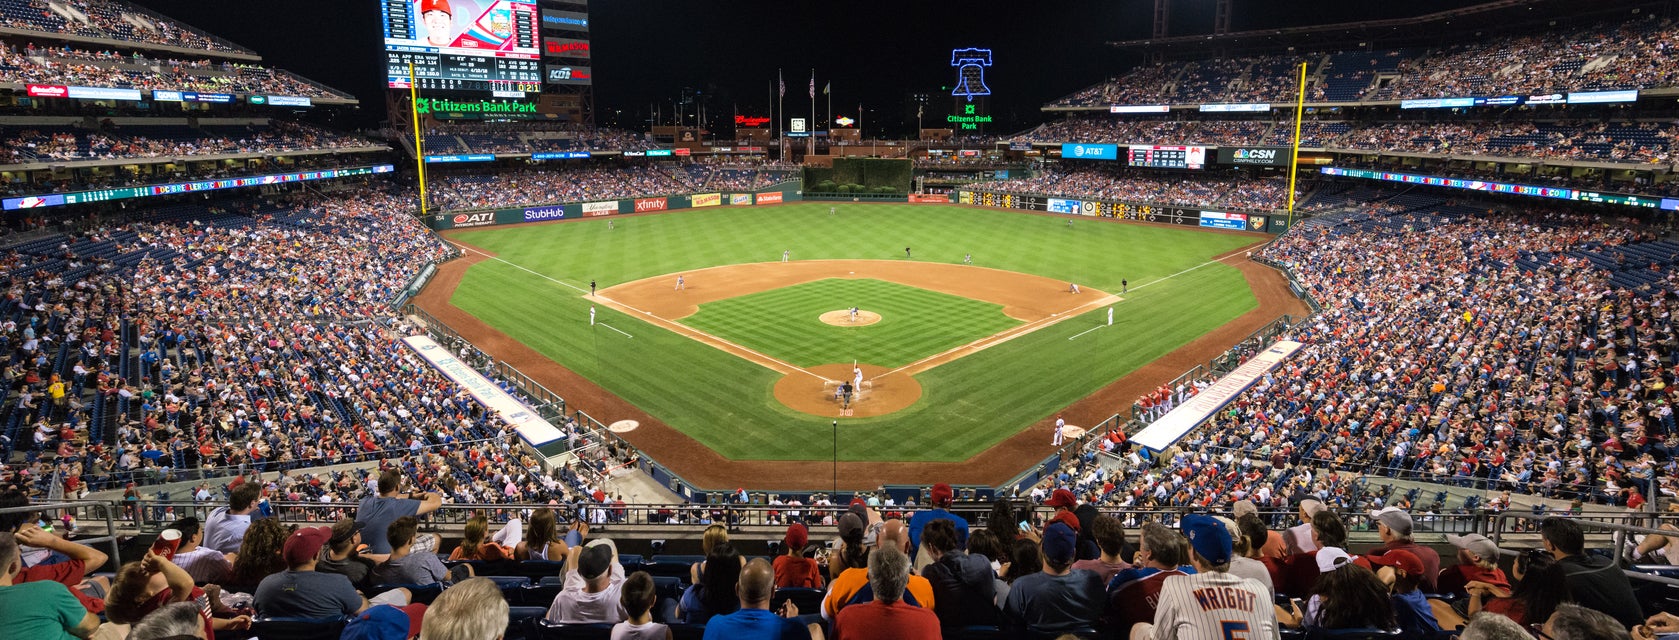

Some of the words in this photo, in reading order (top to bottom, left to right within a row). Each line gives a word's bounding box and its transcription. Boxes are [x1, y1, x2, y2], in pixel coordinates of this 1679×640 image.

[432, 100, 480, 112] Citizens
[483, 101, 510, 112] Bank
[513, 102, 536, 112] Park
[1249, 149, 1276, 159] CSN
[637, 200, 664, 211] xfinity
[468, 213, 494, 222] ATI
[525, 209, 564, 219] StubHub
[1193, 585, 1256, 613] WRIGHT
